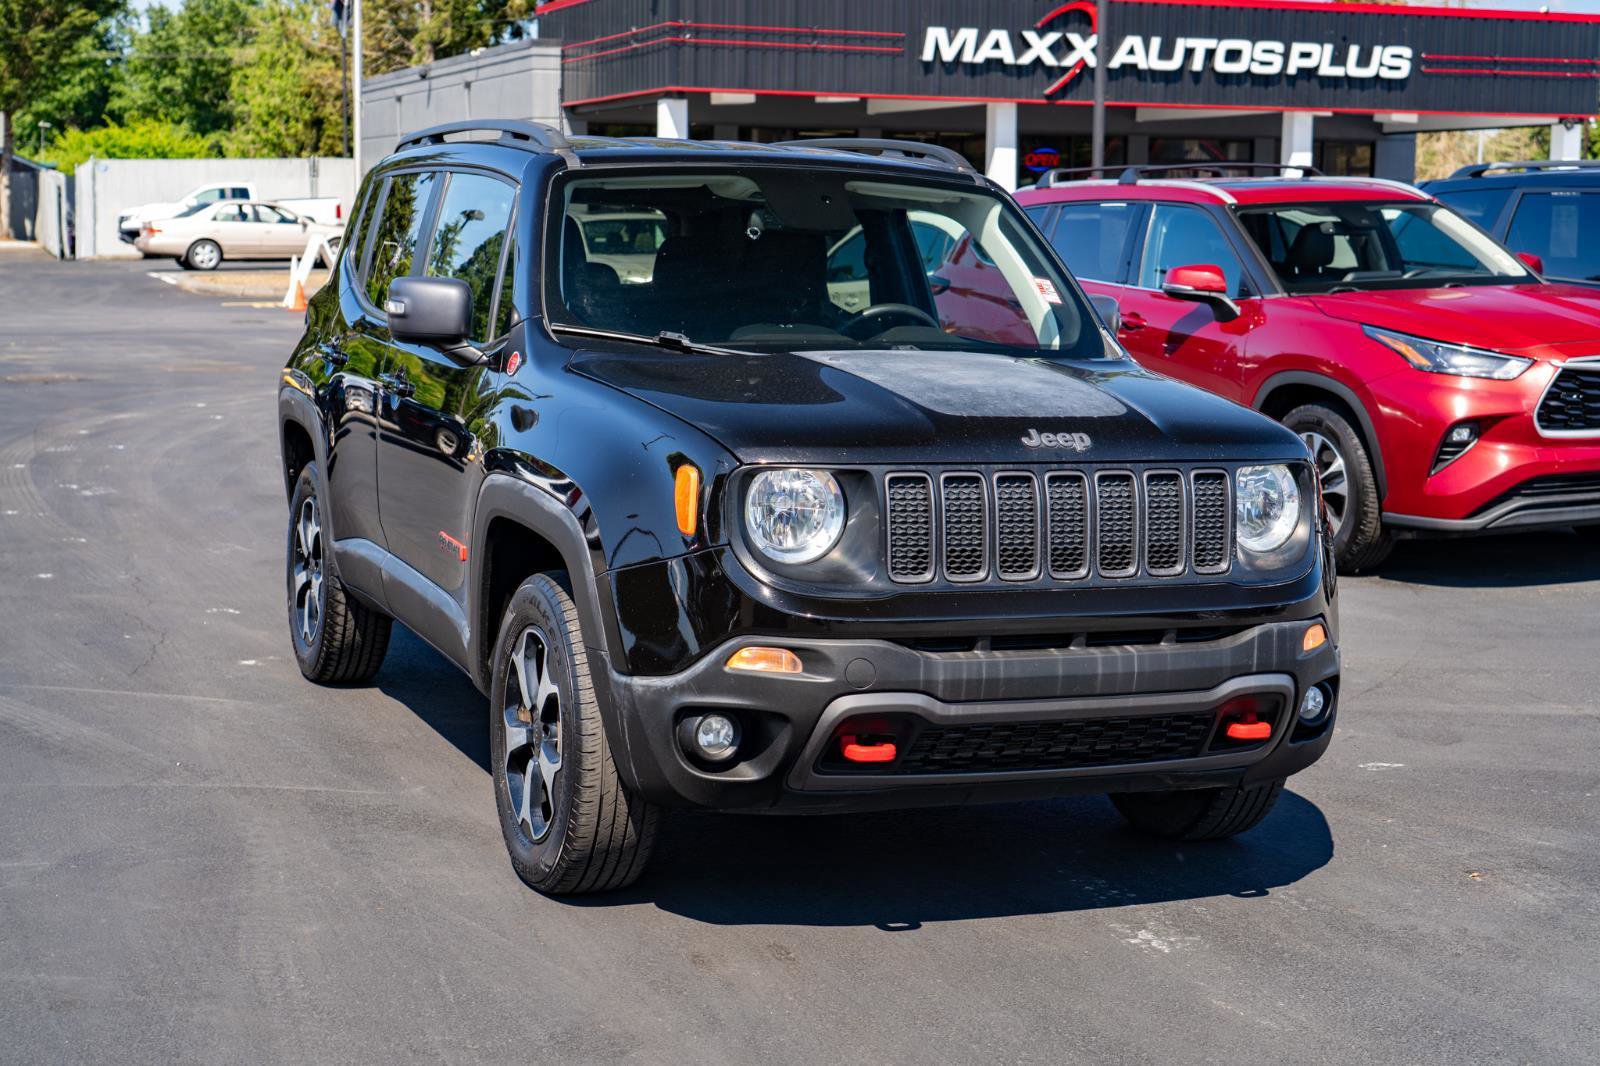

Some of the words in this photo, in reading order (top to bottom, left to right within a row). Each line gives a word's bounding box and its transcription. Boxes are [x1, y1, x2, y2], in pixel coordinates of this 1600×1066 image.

[921, 26, 1098, 69] MAXX
[1107, 35, 1285, 76] AUTOS
[1286, 42, 1413, 80] PLUS
[1024, 153, 1060, 167] OPEN
[1021, 428, 1092, 453] Jeep
